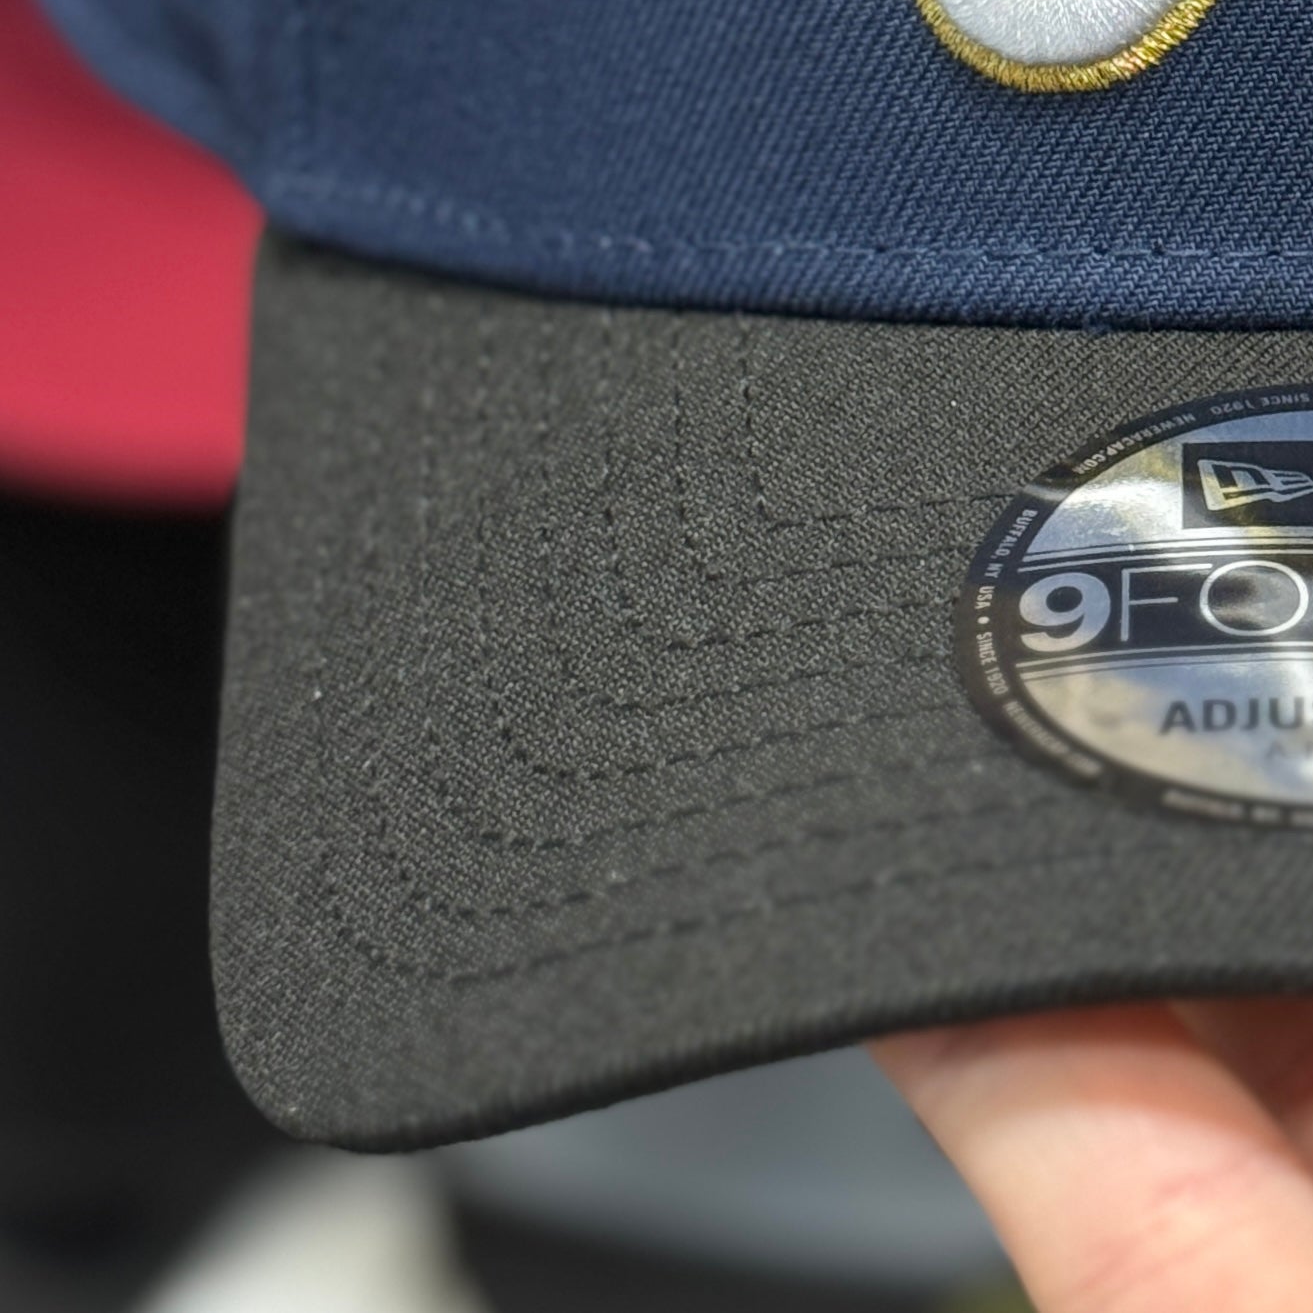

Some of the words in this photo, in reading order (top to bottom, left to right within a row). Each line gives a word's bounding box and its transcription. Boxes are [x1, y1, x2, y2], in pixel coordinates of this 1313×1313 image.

[1209, 397, 1255, 416] 1920
[1258, 392, 1310, 409] SINCE
[1073, 412, 1196, 475] NEWERACAP.COM
[992, 509, 1038, 561] BUFFALO,
[974, 585, 996, 611] USA
[976, 630, 998, 668] SINCE
[985, 667, 1010, 696] 1920
